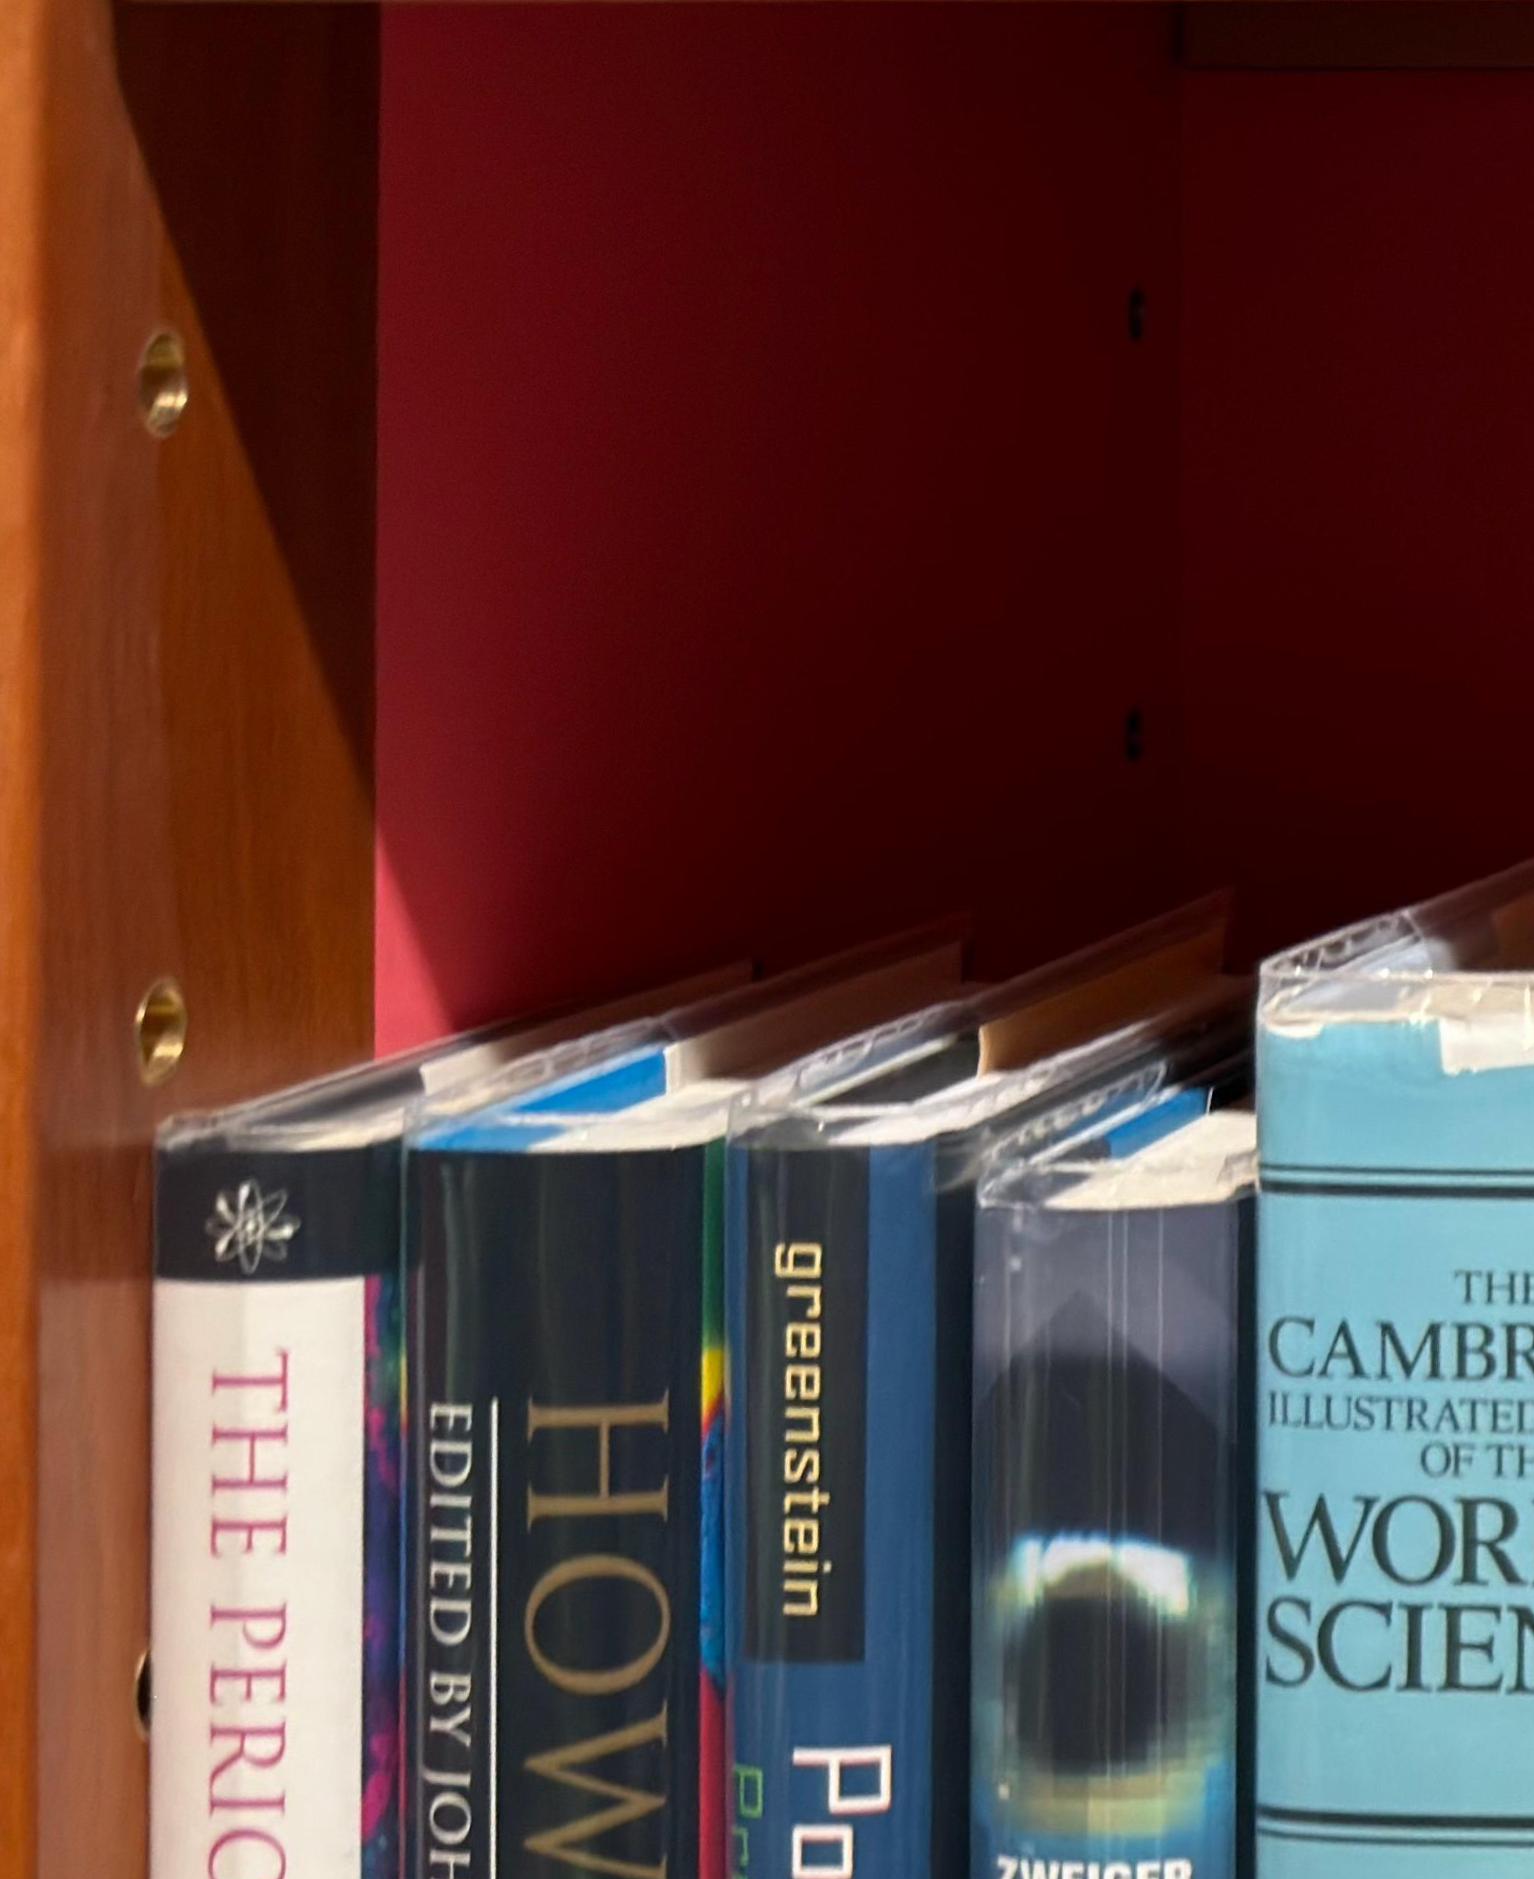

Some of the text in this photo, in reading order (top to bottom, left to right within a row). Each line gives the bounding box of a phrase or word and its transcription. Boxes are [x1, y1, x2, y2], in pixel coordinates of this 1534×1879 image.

[209, 1350, 288, 1558] THE
[428, 1403, 472, 1648] EDITED
[775, 1243, 822, 1618] greenstein
